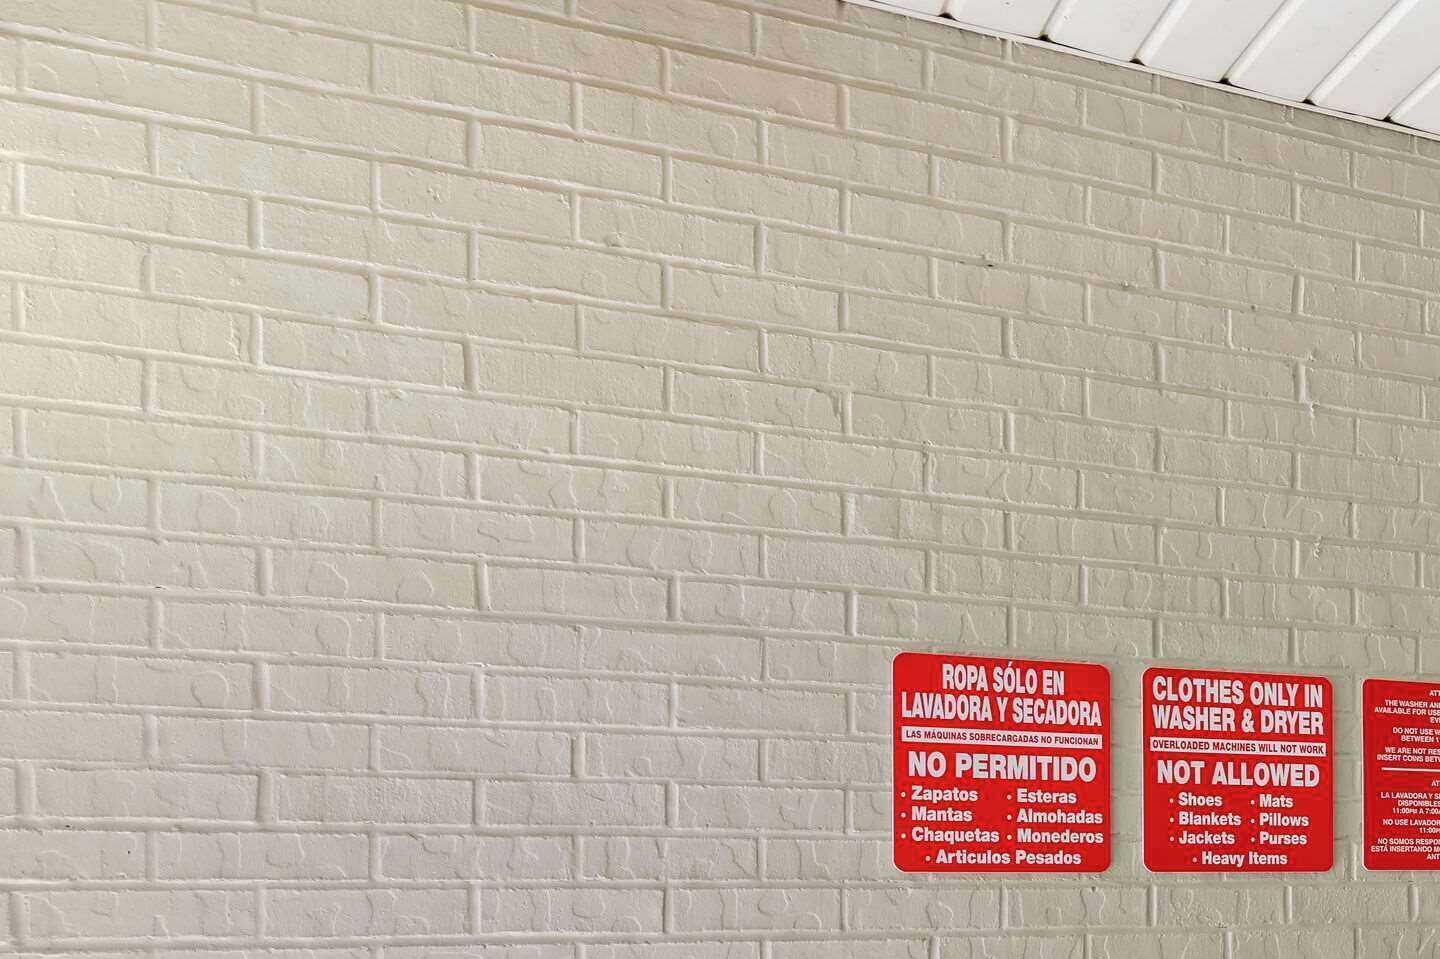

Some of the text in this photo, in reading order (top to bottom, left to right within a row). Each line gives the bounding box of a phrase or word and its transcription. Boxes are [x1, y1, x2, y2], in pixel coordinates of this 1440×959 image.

[942, 660, 1064, 695] ROPA SÓLO EN
[1152, 675, 1322, 707] CLOTHES ONLY IN
[901, 691, 1101, 726] LAVADORA Y SECADORA
[1374, 706, 1410, 714] AVAILABLE
[1398, 700, 1427, 708] WASHER
[1151, 704, 1323, 735] WASHER & DRYER
[906, 729, 1098, 745] LAS MÁQUINAS SOBRECARGADAS NO FUNCIONAN
[1152, 739, 1323, 754] OVERLOADED MACHINES WILL NOT WORK
[908, 750, 1096, 781] NO PERMITIDO
[1157, 759, 1319, 787] NOT ALLOWED
[911, 785, 977, 802] Zapatos
[1017, 788, 1076, 803] Esteras
[1178, 791, 1222, 806] Shoes
[1259, 793, 1293, 807] Mats
[911, 806, 972, 821] Mantas
[1016, 808, 1102, 823] Almohadas
[1179, 811, 1241, 825] Blankets
[1259, 812, 1308, 826] Pillows
[911, 826, 999, 844] Chaquetas
[1017, 828, 1103, 843] Monederos
[1178, 830, 1234, 844] Jackets
[1259, 831, 1306, 844] Purses
[1015, 849, 1081, 864] Pesados
[1202, 851, 1287, 867] Heavy Items
